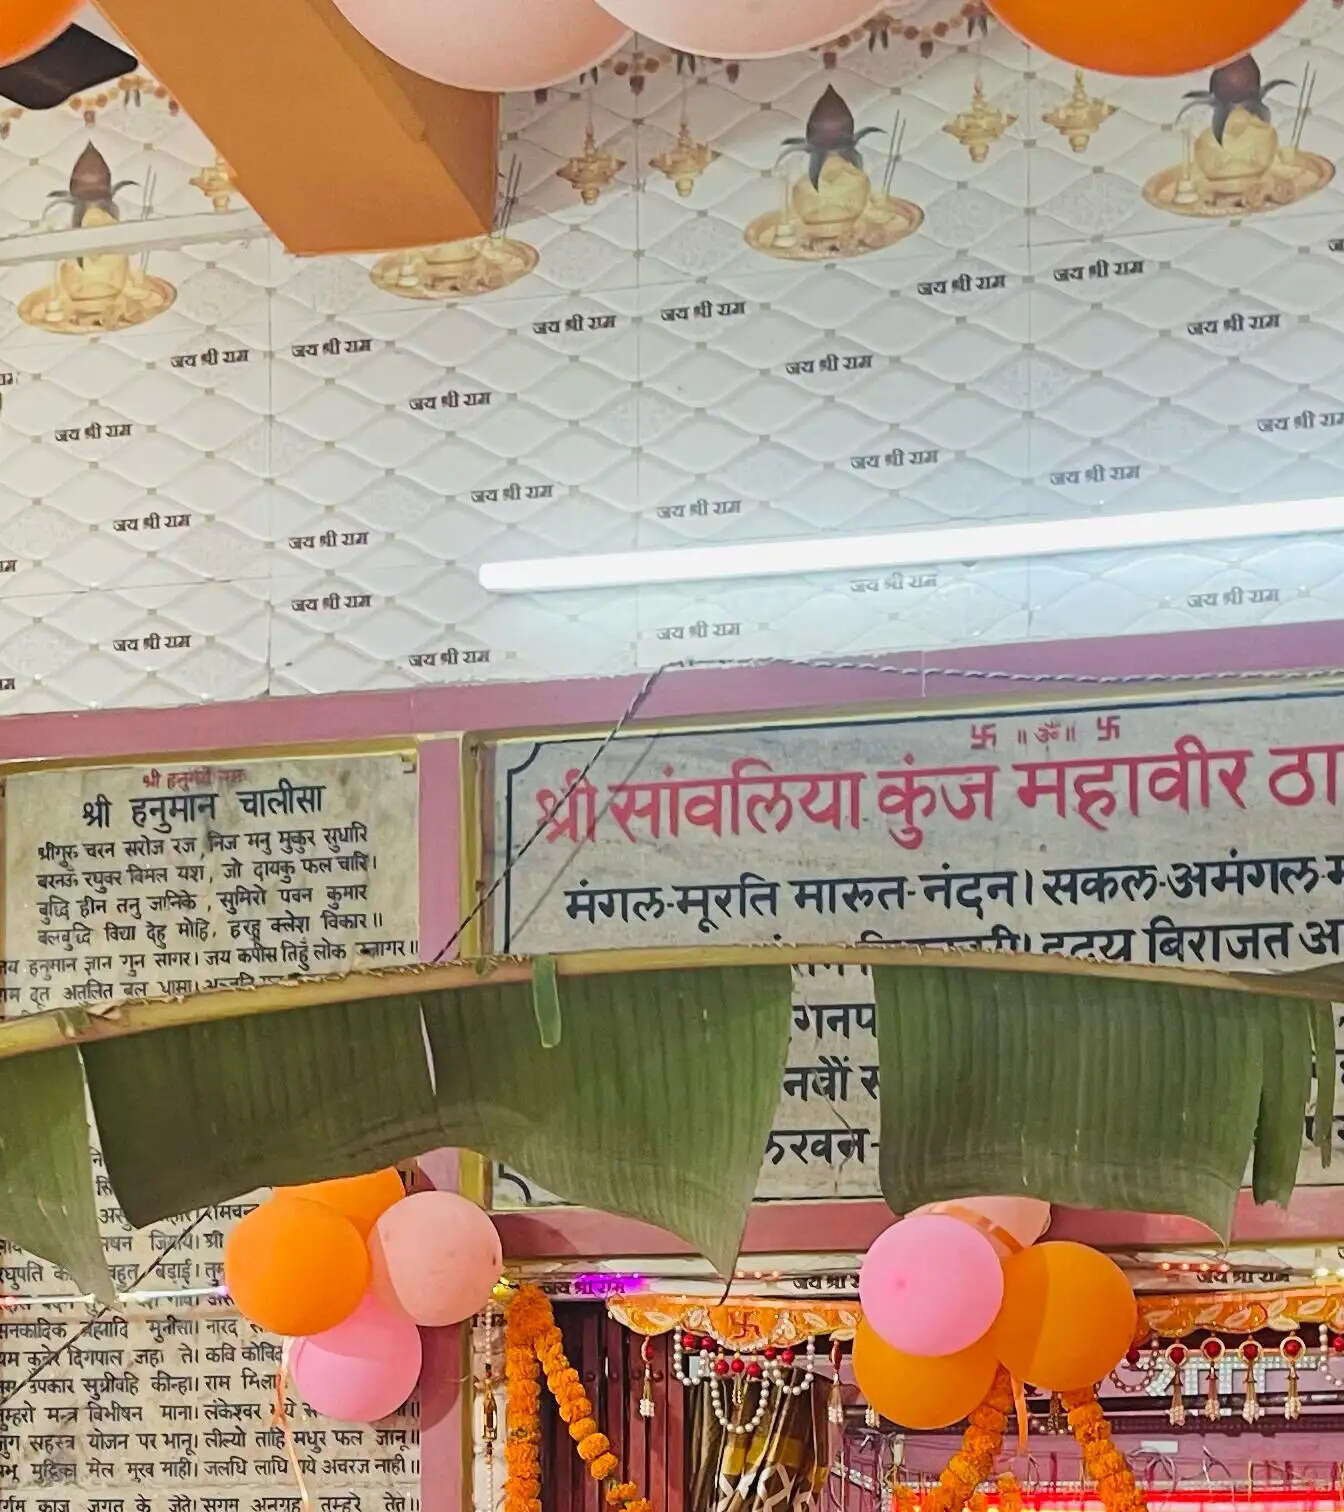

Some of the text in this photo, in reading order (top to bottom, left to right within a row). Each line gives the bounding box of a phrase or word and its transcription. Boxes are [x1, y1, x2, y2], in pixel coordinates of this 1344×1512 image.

[533, 314, 616, 334] जय श्री राम
[171, 348, 249, 368] जय श्री राम
[114, 512, 191, 531] जय श्री राम
[531, 764, 603, 850] श्री
[603, 756, 867, 843] सांवलिया
[877, 753, 1000, 850] कुंज
[1012, 729, 1253, 831] महावीर
[83, 794, 112, 828] श्री
[129, 793, 220, 834] हनुमान
[236, 778, 326, 817] चालीसा
[82, 843, 115, 858] चरन
[123, 835, 164, 856] सरोज
[76, 896, 106, 918] हीन
[117, 898, 142, 919] तनु
[326, 884, 368, 910] कुमार
[1142, 915, 1294, 964] बिराजत
